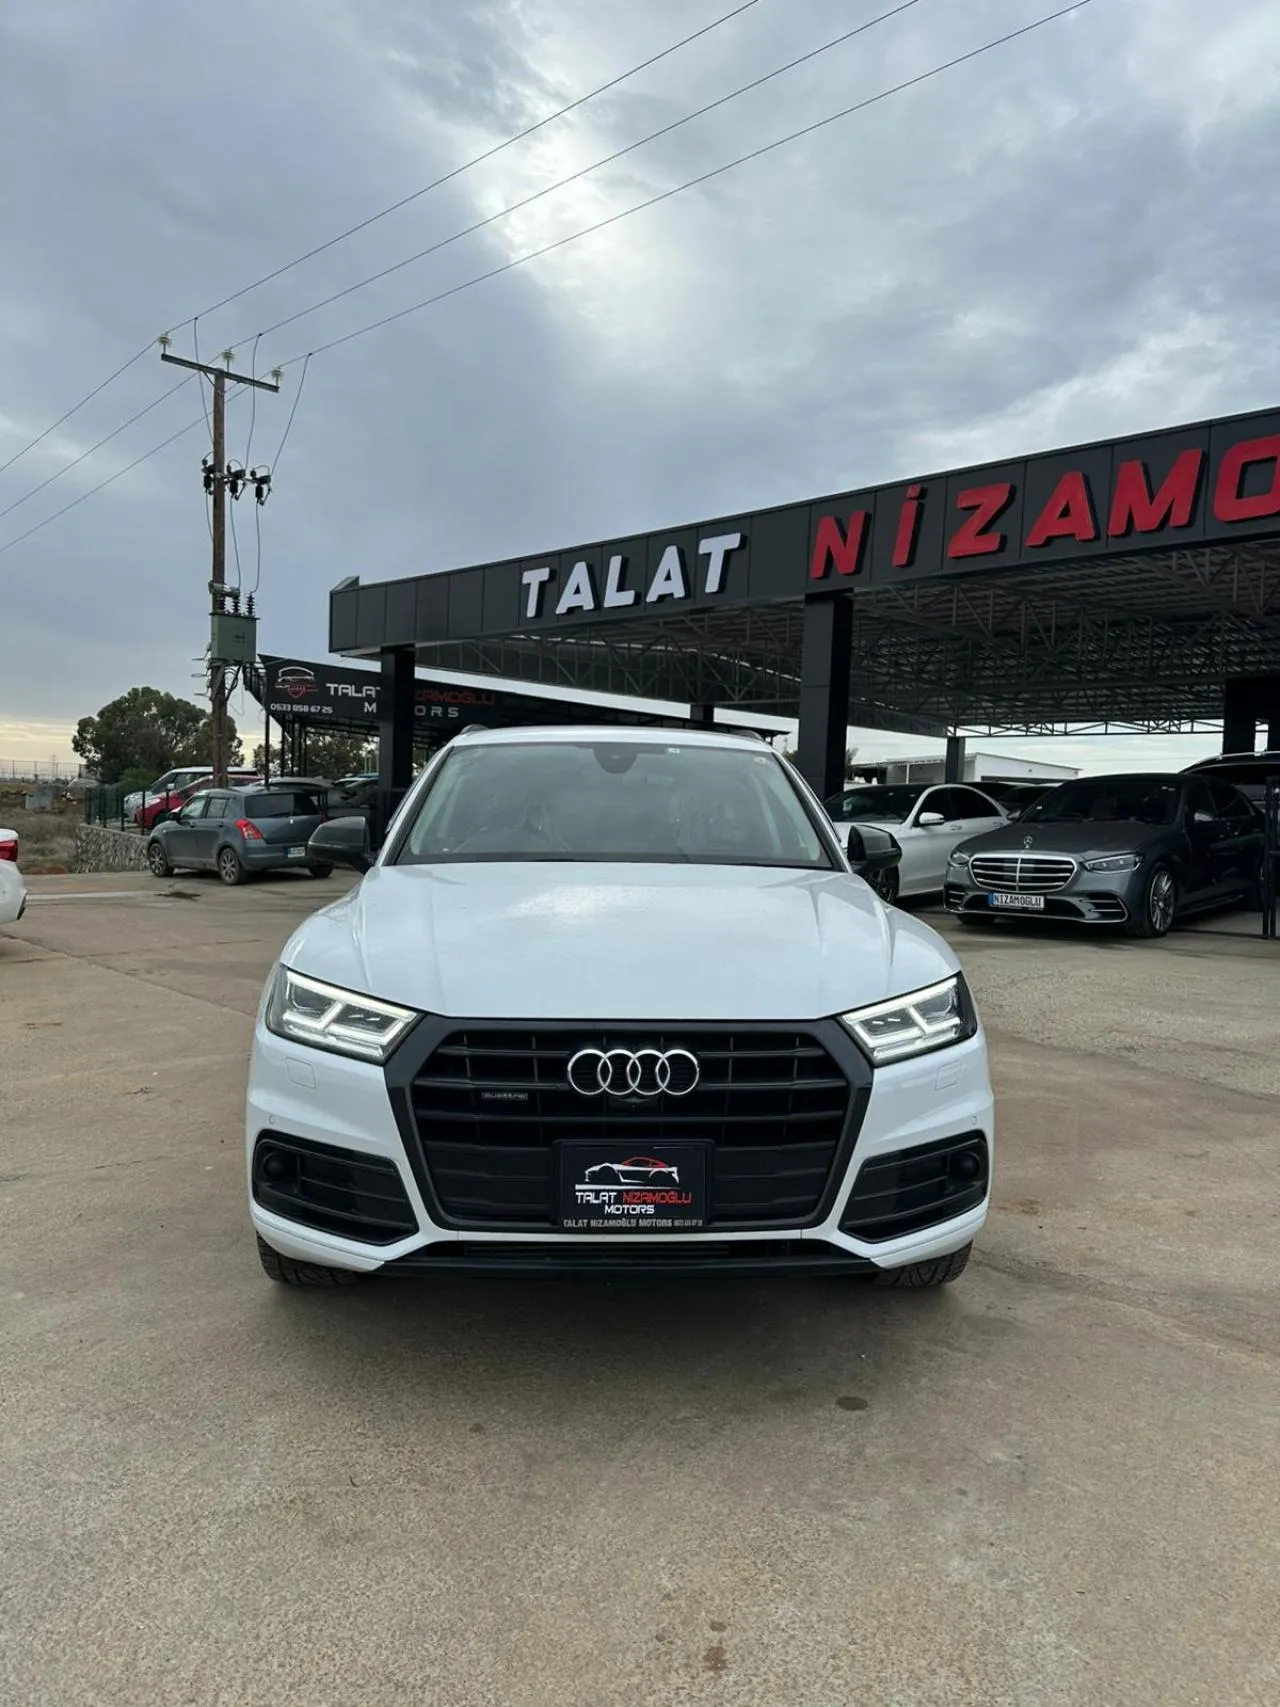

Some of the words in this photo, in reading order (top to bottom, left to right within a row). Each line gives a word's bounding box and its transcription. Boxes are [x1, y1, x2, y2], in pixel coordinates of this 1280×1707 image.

[522, 532, 741, 618] TALAT
[270, 703, 291, 711] 0533
[310, 704, 321, 713] 67
[576, 1192, 617, 1204] TALAT
[604, 1204, 655, 1215] MOTORS
[638, 1218, 672, 1227] MOTORS
